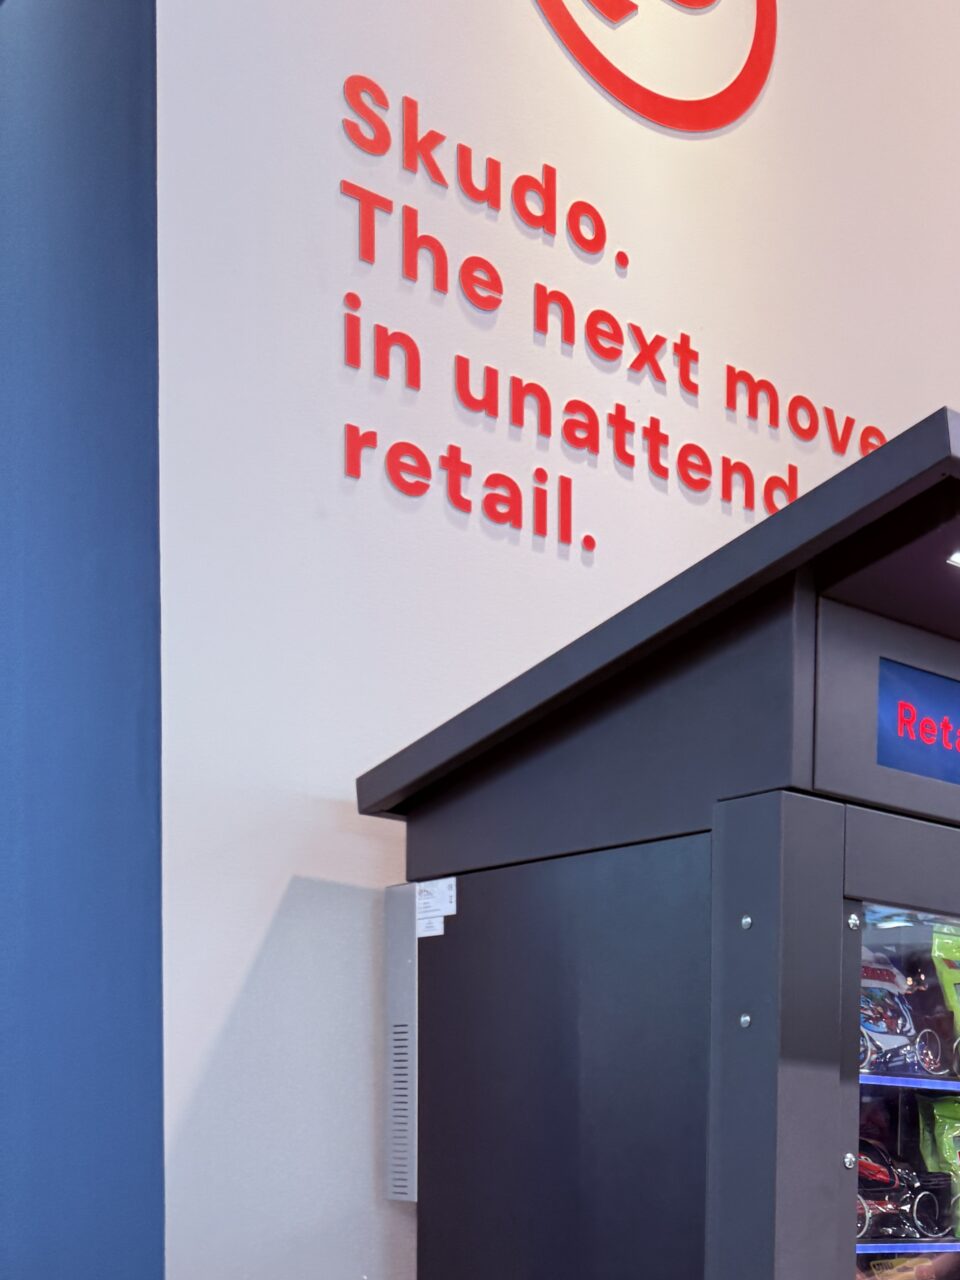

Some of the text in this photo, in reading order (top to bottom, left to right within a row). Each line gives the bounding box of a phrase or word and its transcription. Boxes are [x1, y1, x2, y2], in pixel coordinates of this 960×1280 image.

[342, 75, 629, 269] Skudo.
[340, 180, 887, 457] The next move
[344, 292, 798, 516] in unattend
[344, 422, 596, 551] retail.
